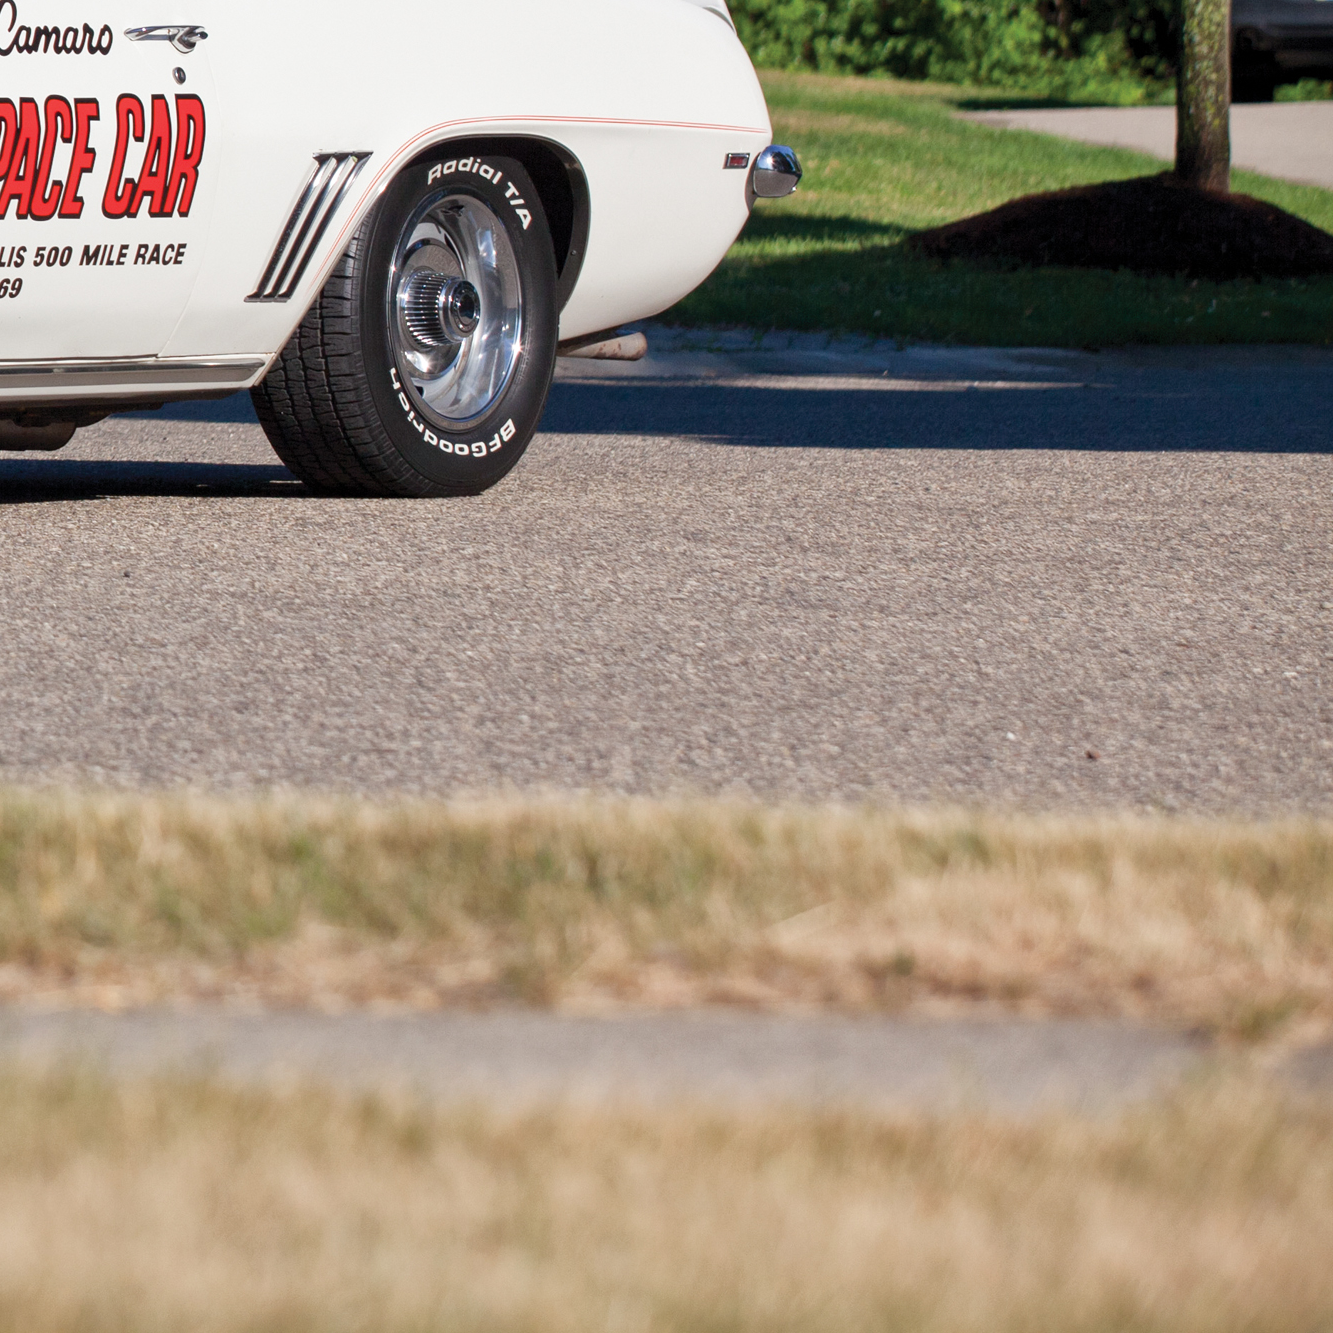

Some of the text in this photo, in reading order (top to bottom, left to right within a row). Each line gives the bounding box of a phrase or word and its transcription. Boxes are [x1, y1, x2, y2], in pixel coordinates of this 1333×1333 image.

[102, 93, 207, 219] CAR
[427, 156, 532, 231] Radial T/A
[32, 245, 73, 268] 500
[78, 244, 129, 267] MILE
[133, 242, 187, 266] RACE
[390, 367, 517, 458] BFGoodrich
